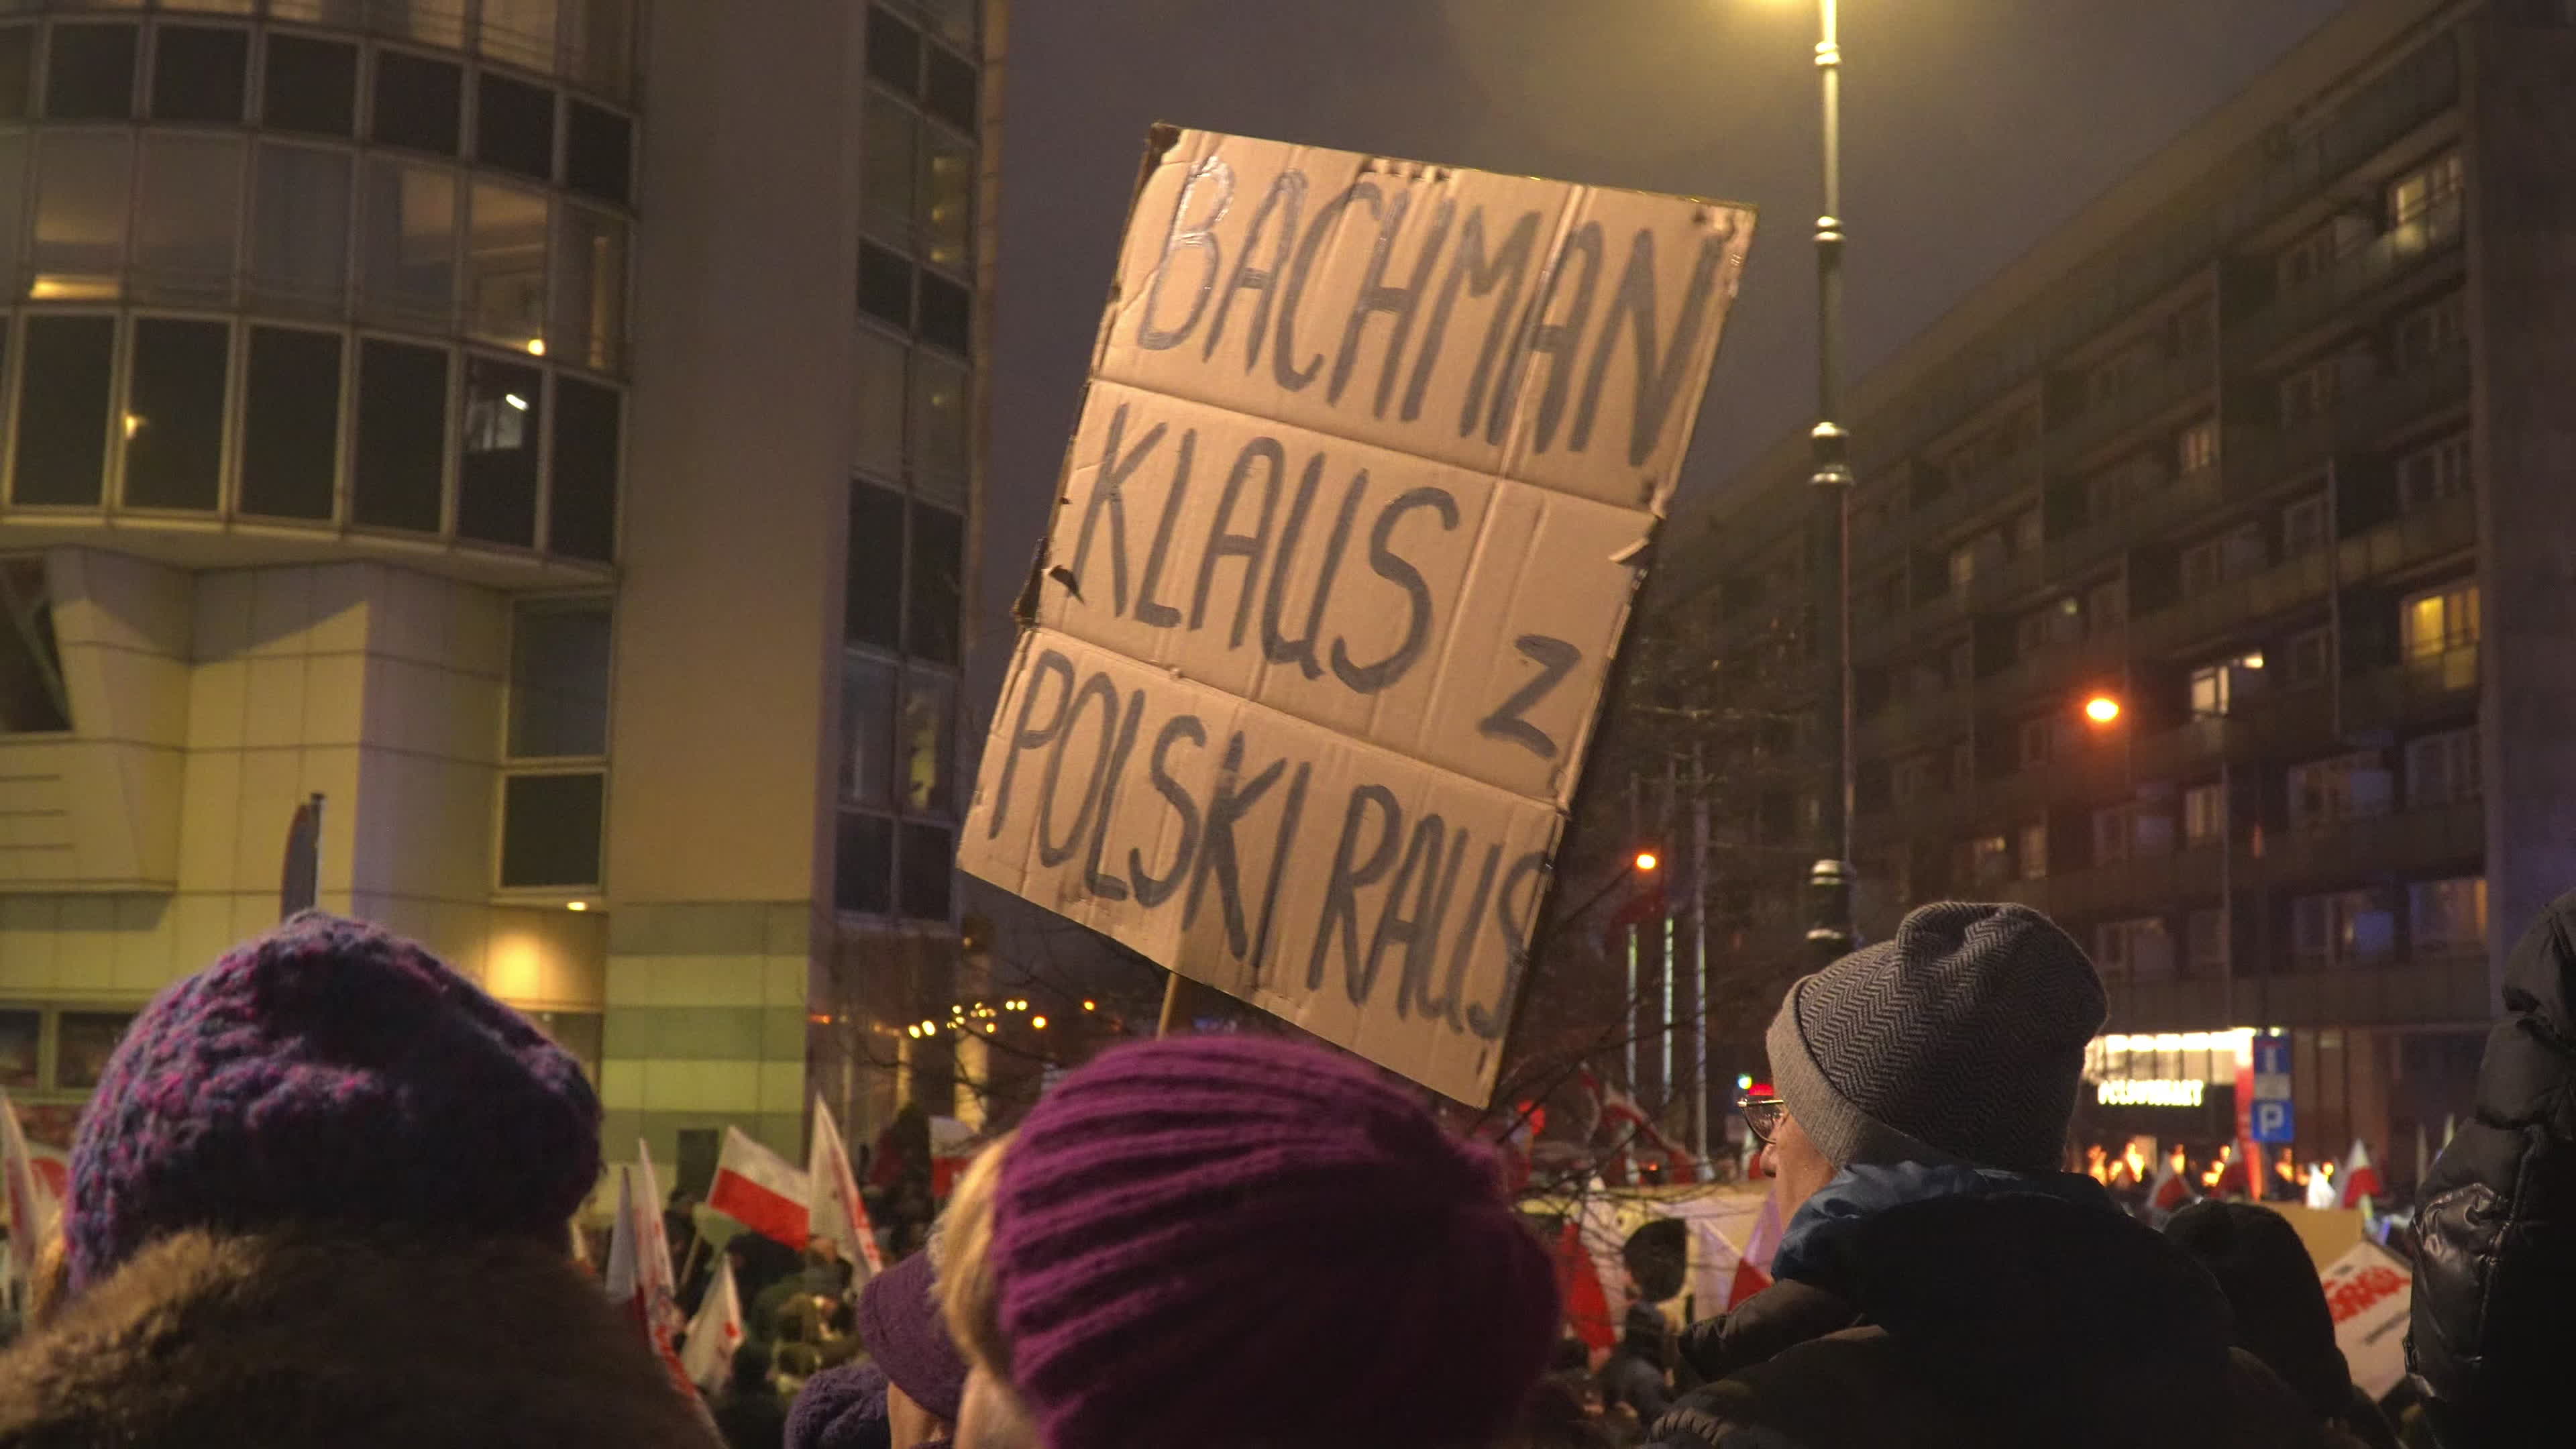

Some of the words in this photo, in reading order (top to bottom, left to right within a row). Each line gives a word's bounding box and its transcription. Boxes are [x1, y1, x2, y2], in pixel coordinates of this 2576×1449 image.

[1137, 155, 1724, 468] BACHMAN
[1075, 404, 1459, 695] KLAUS
[988, 648, 1312, 969] POLSKI
[1306, 784, 1551, 1039] RAUS
[2259, 1104, 2284, 1137] P
